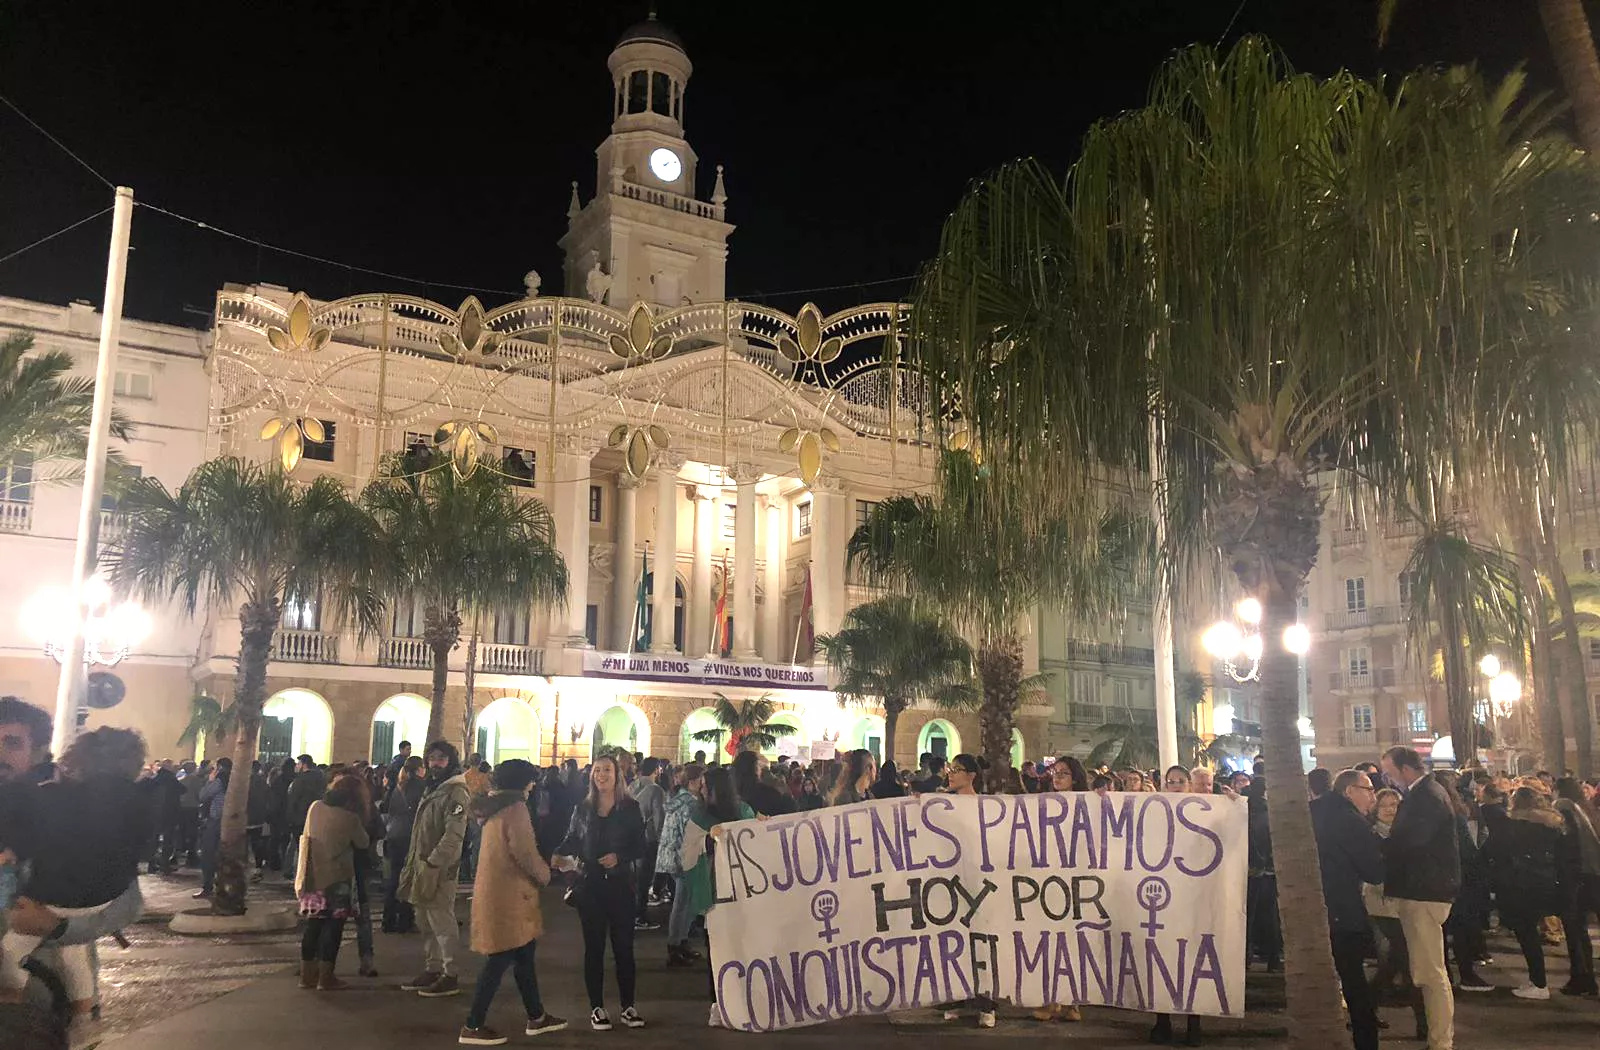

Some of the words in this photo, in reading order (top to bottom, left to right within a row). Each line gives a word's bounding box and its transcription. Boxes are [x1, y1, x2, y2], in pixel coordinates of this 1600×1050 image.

[602, 658, 626, 671] #NI
[629, 659, 650, 672] UNA
[653, 660, 690, 674] MENOS
[703, 663, 741, 677] #VIVAS
[743, 667, 763, 678] NOS
[765, 668, 815, 683] QUEREMOS
[713, 827, 768, 904] LAS
[977, 794, 1224, 877] PARAMOS
[871, 874, 998, 933] HOY
[1012, 875, 1111, 922] POR
[717, 930, 973, 1033] CONQUISTAR
[1013, 919, 1231, 1016] MAÑANA
